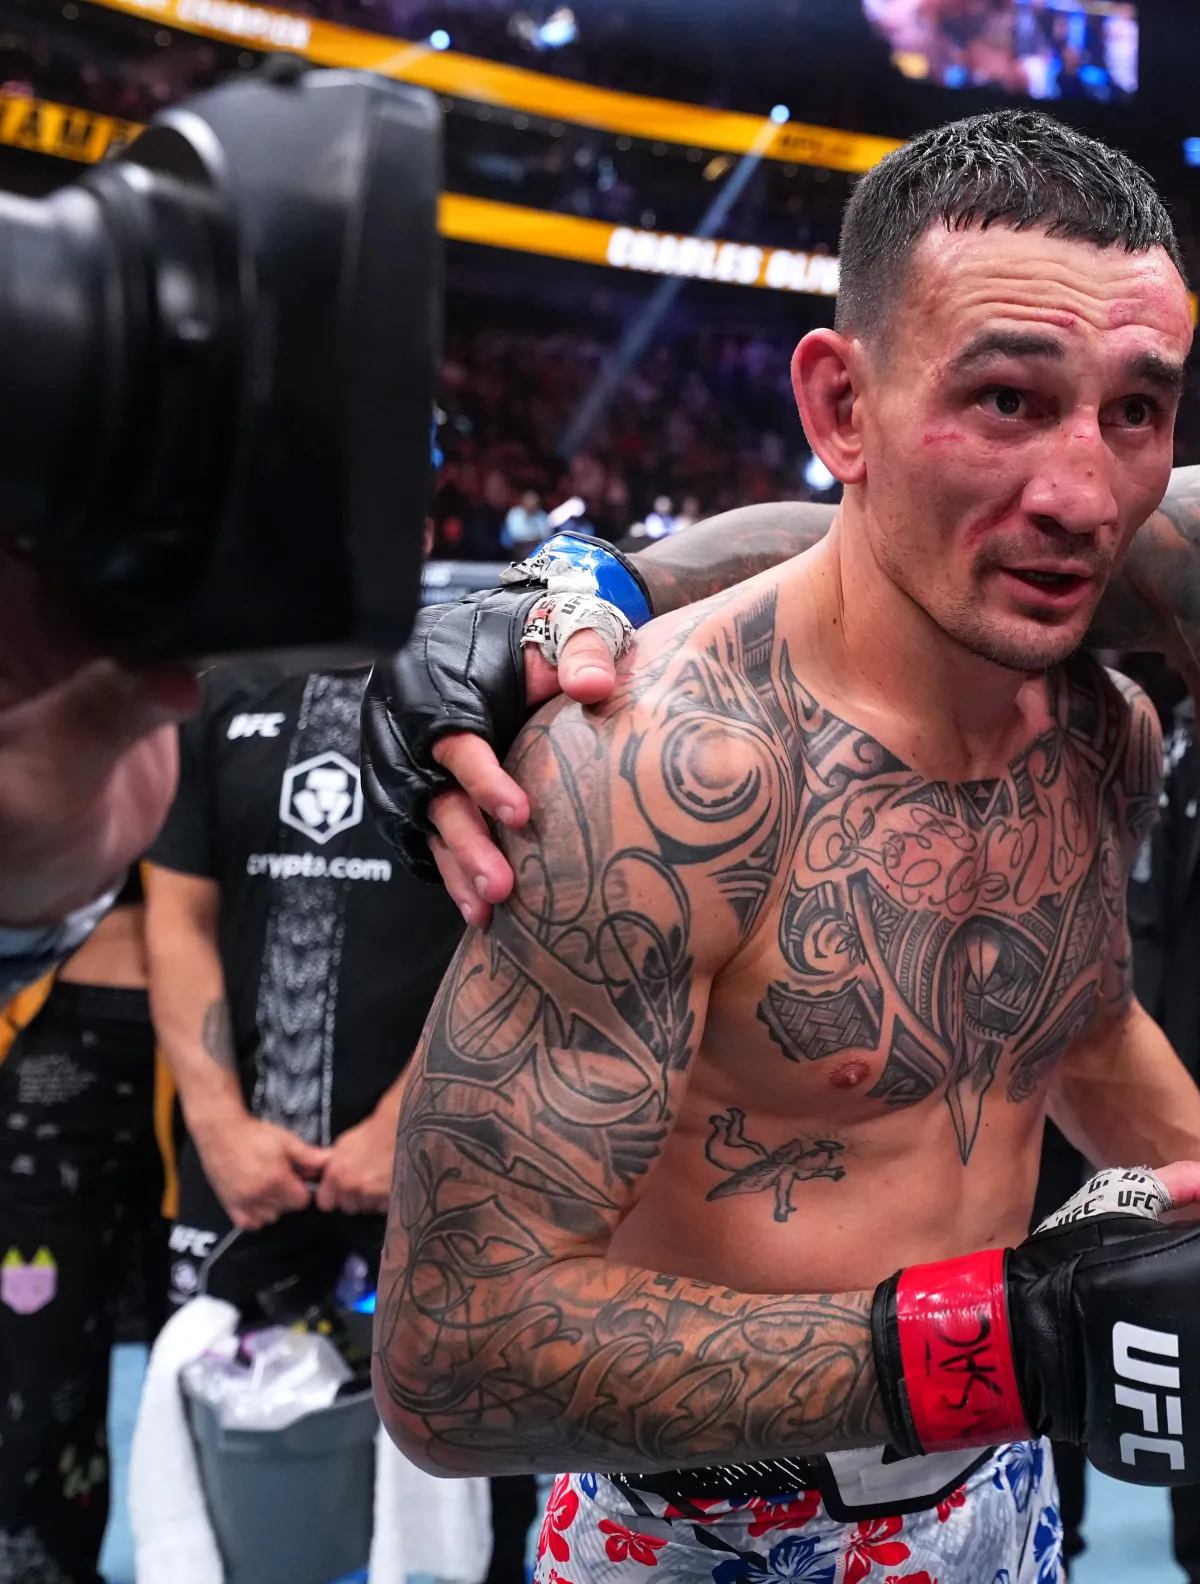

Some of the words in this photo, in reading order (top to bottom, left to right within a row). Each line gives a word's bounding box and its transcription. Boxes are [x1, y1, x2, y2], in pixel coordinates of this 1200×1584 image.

[606, 226, 761, 285] CHARLES
[226, 711, 286, 740] UFC
[246, 852, 392, 882] crypto.com
[1117, 1190, 1160, 1211] UFC
[1111, 1320, 1186, 1471] UFC
